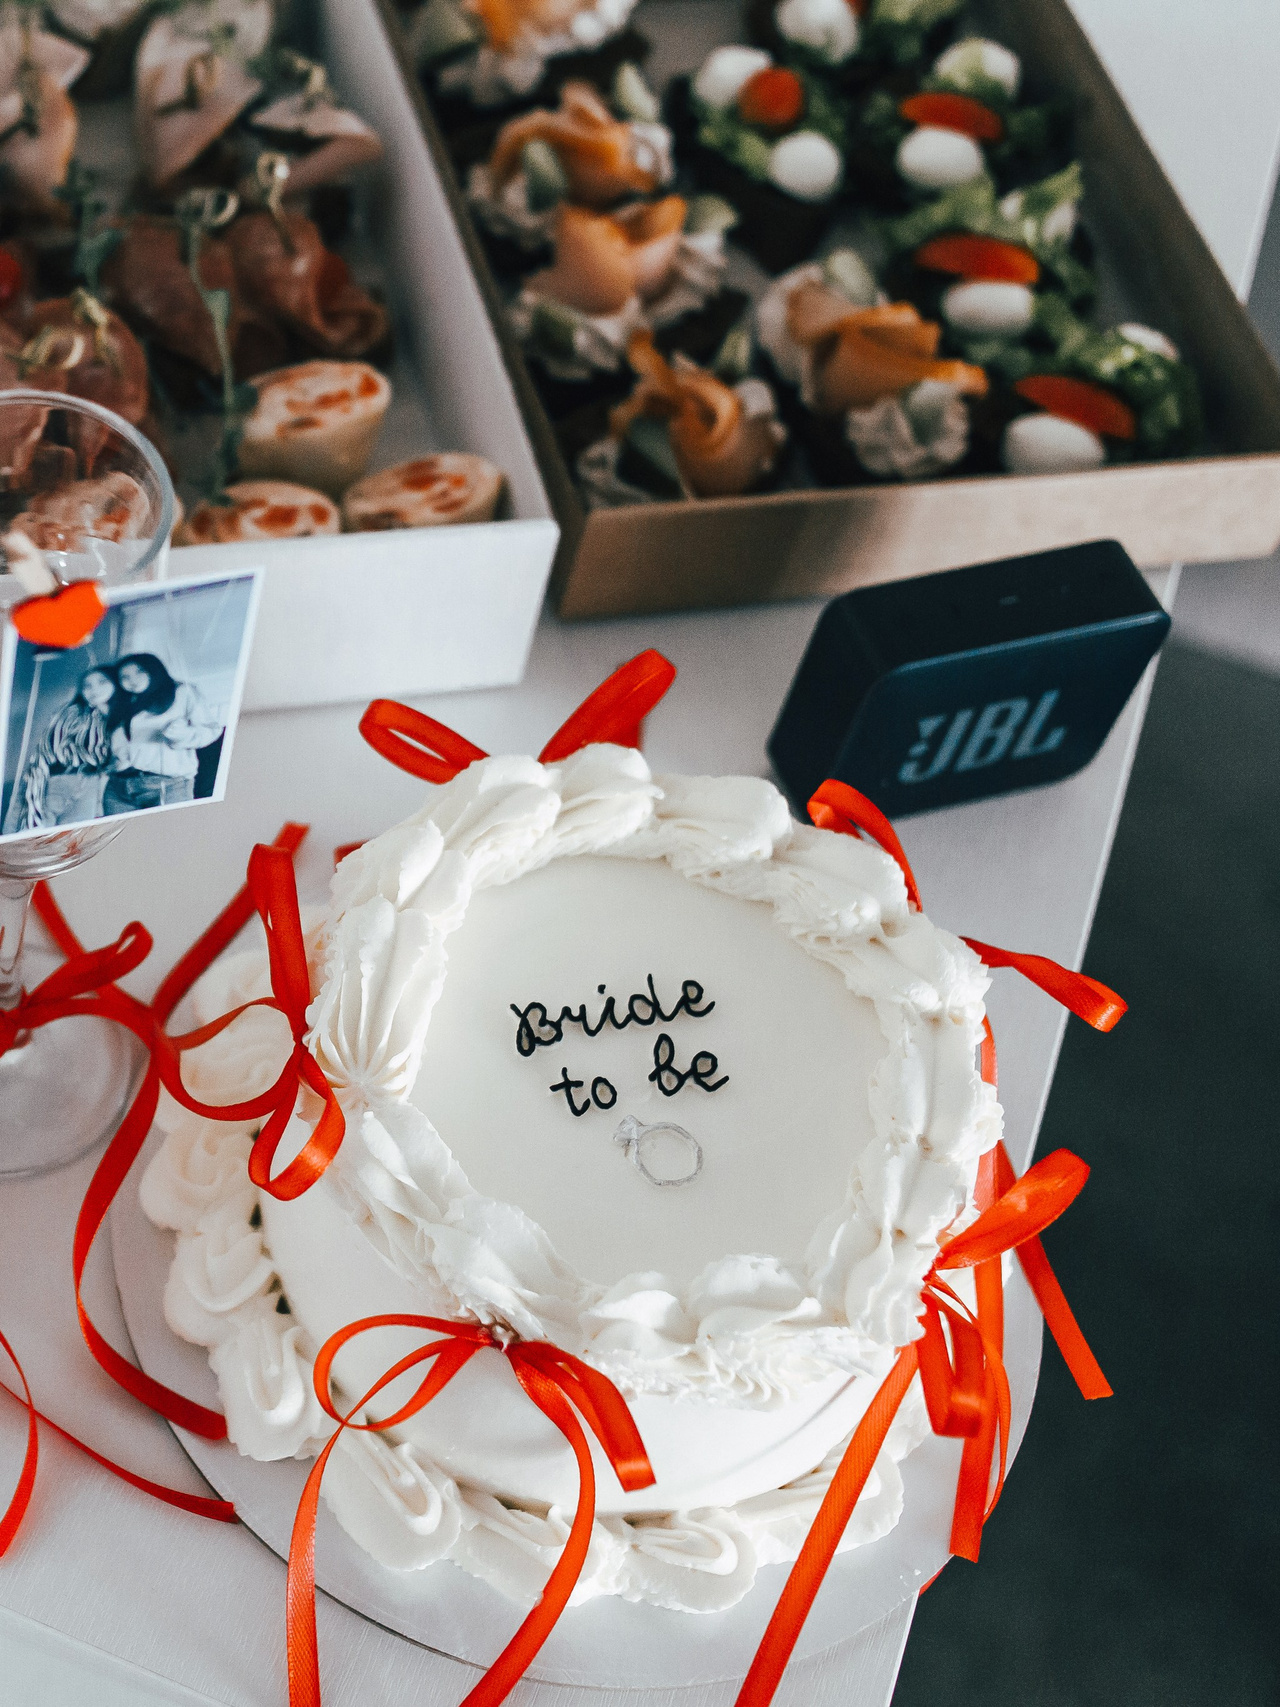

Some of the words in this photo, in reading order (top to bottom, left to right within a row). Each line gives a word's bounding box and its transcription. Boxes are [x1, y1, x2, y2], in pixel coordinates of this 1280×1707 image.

[897, 688, 1067, 785] JBL
[510, 973, 716, 1057] Bride
[549, 1066, 618, 1117] to
[648, 1033, 730, 1097] be
